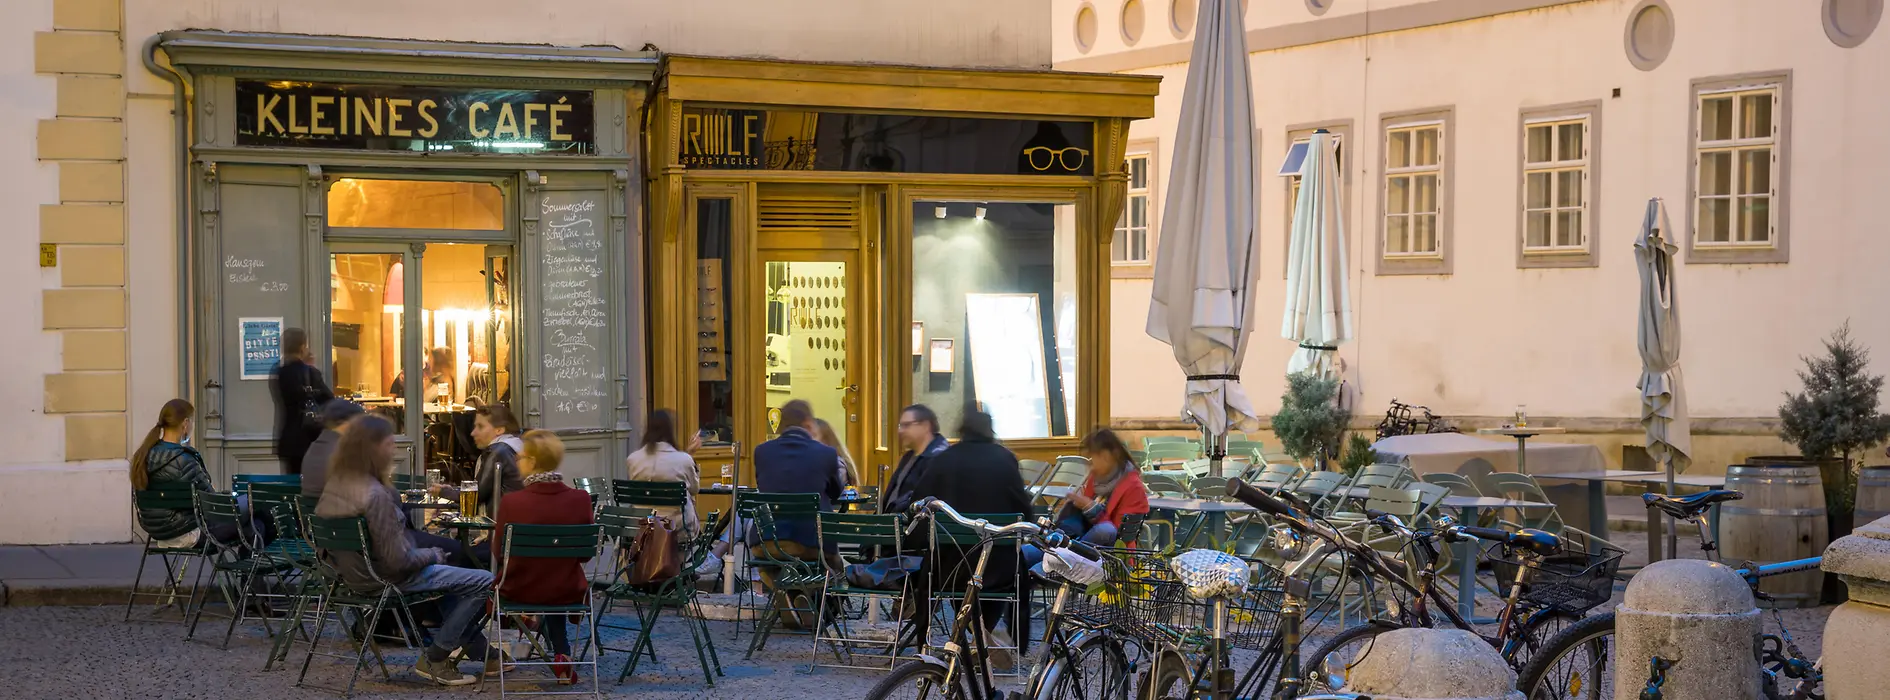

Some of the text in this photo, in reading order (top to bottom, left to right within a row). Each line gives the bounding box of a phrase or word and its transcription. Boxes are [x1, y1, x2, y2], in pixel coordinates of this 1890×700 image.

[257, 93, 573, 141] KLEINES CAFÉ
[684, 157, 758, 166] SPECTACLES
[245, 336, 278, 349] BITTE
